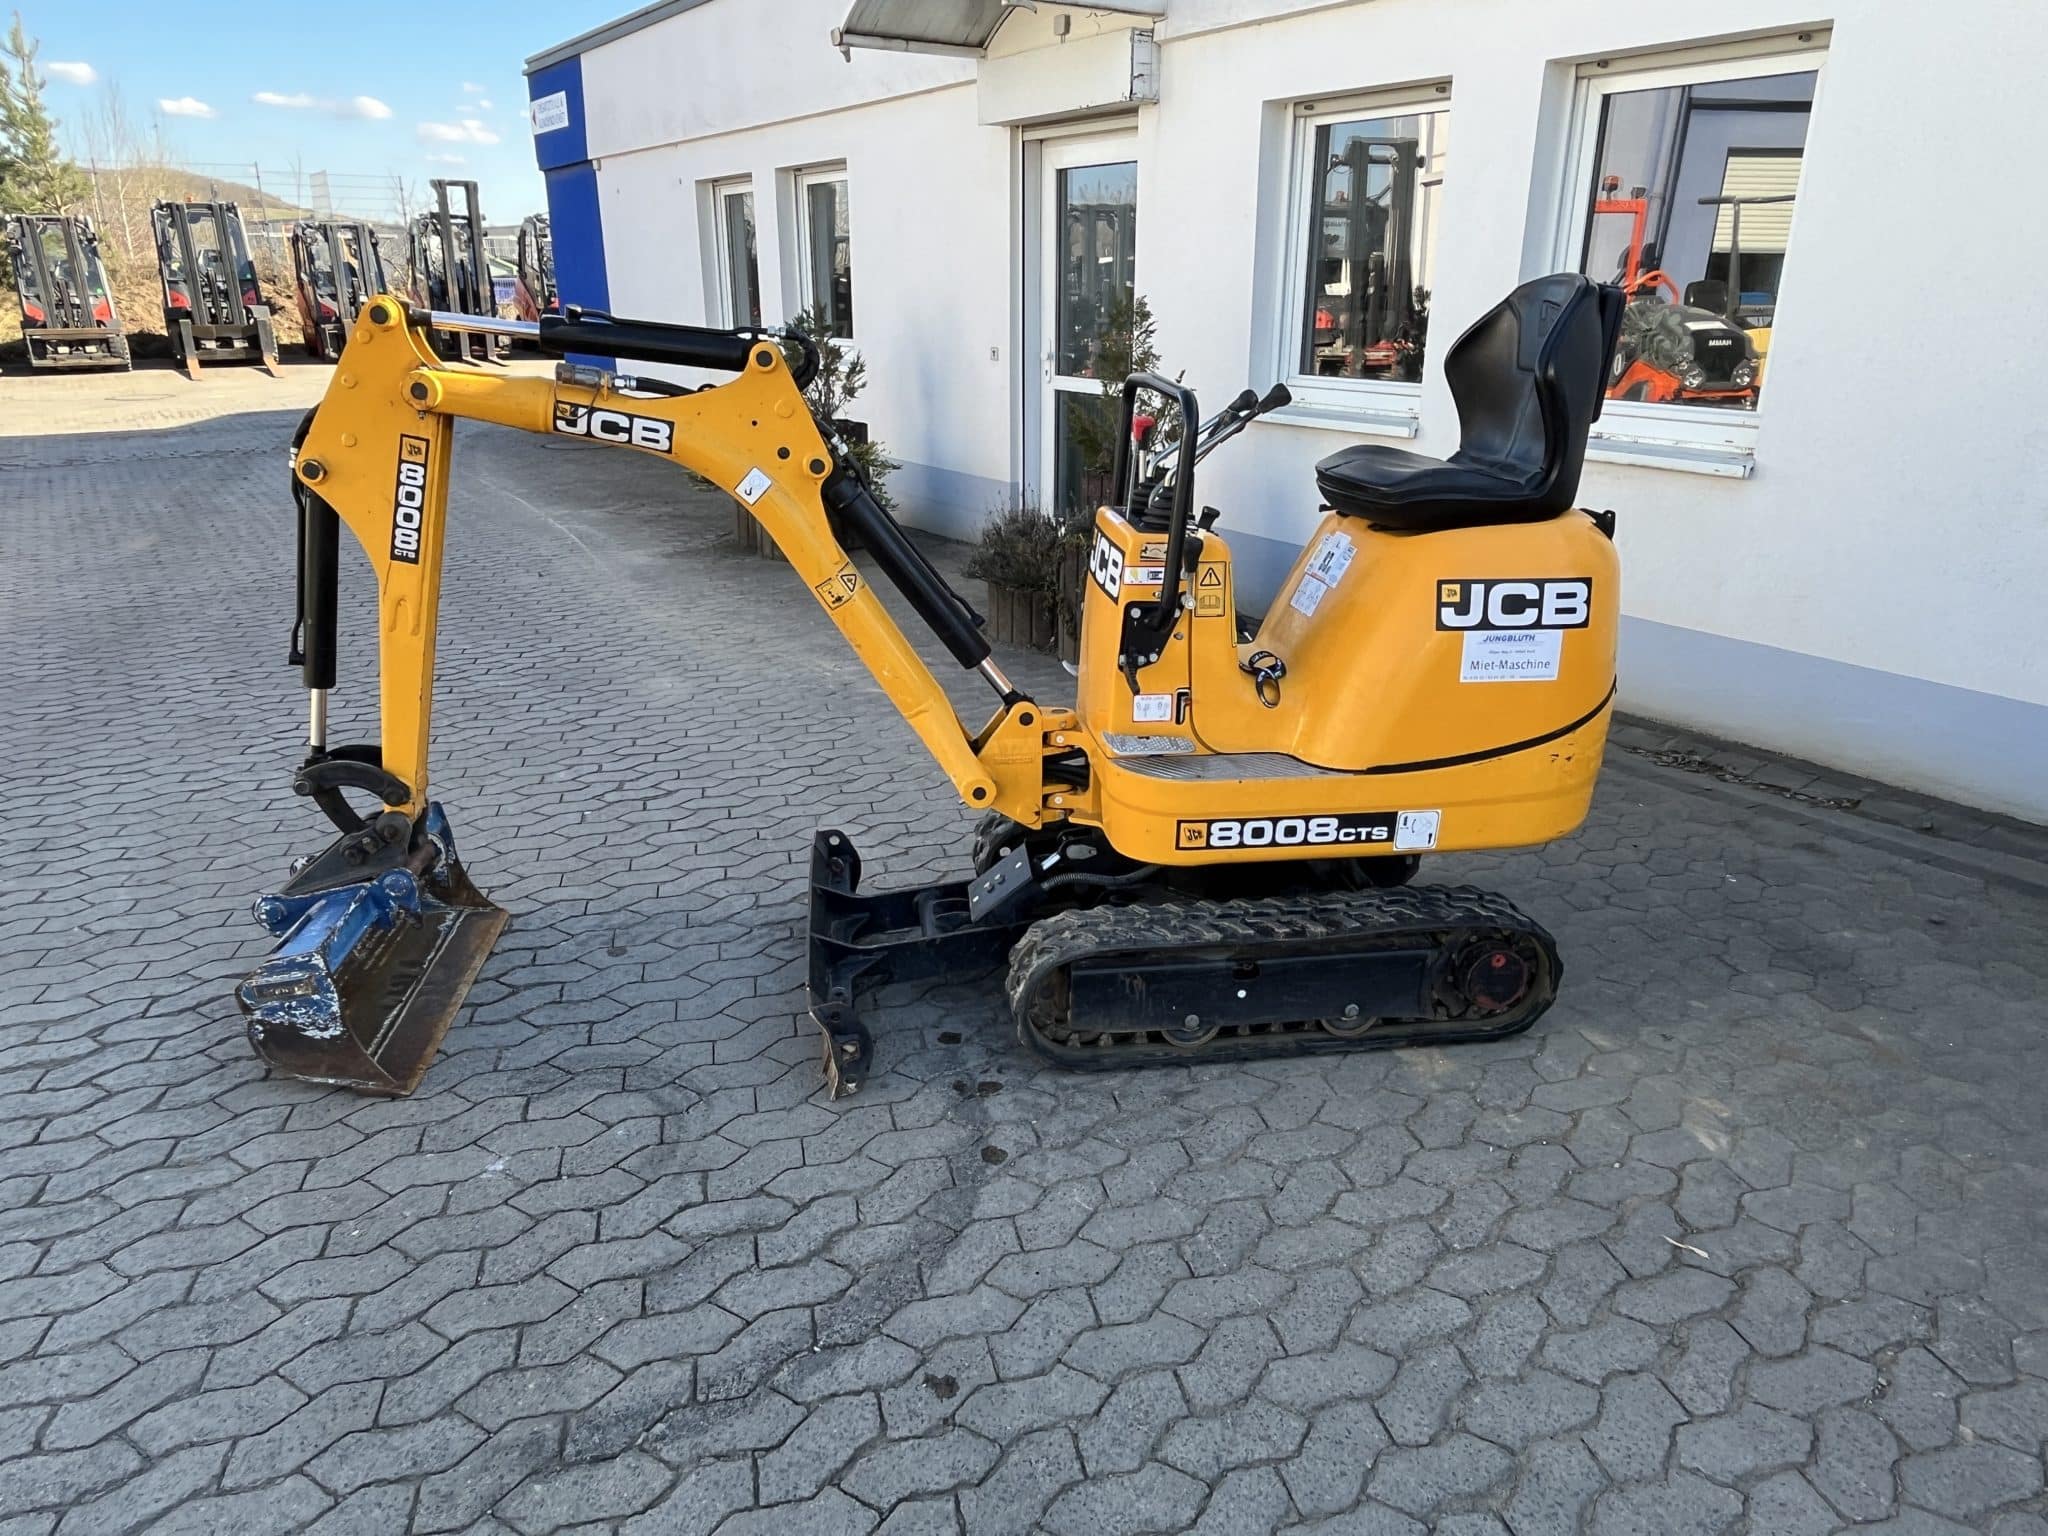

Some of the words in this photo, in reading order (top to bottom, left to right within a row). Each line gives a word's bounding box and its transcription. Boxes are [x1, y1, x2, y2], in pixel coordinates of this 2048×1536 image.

[556, 407, 671, 451] JCB
[394, 462, 425, 551] 8008
[1089, 532, 1123, 598] JCB
[1441, 582, 1588, 627] JCB
[1469, 658, 1551, 671] Miet-Maschine
